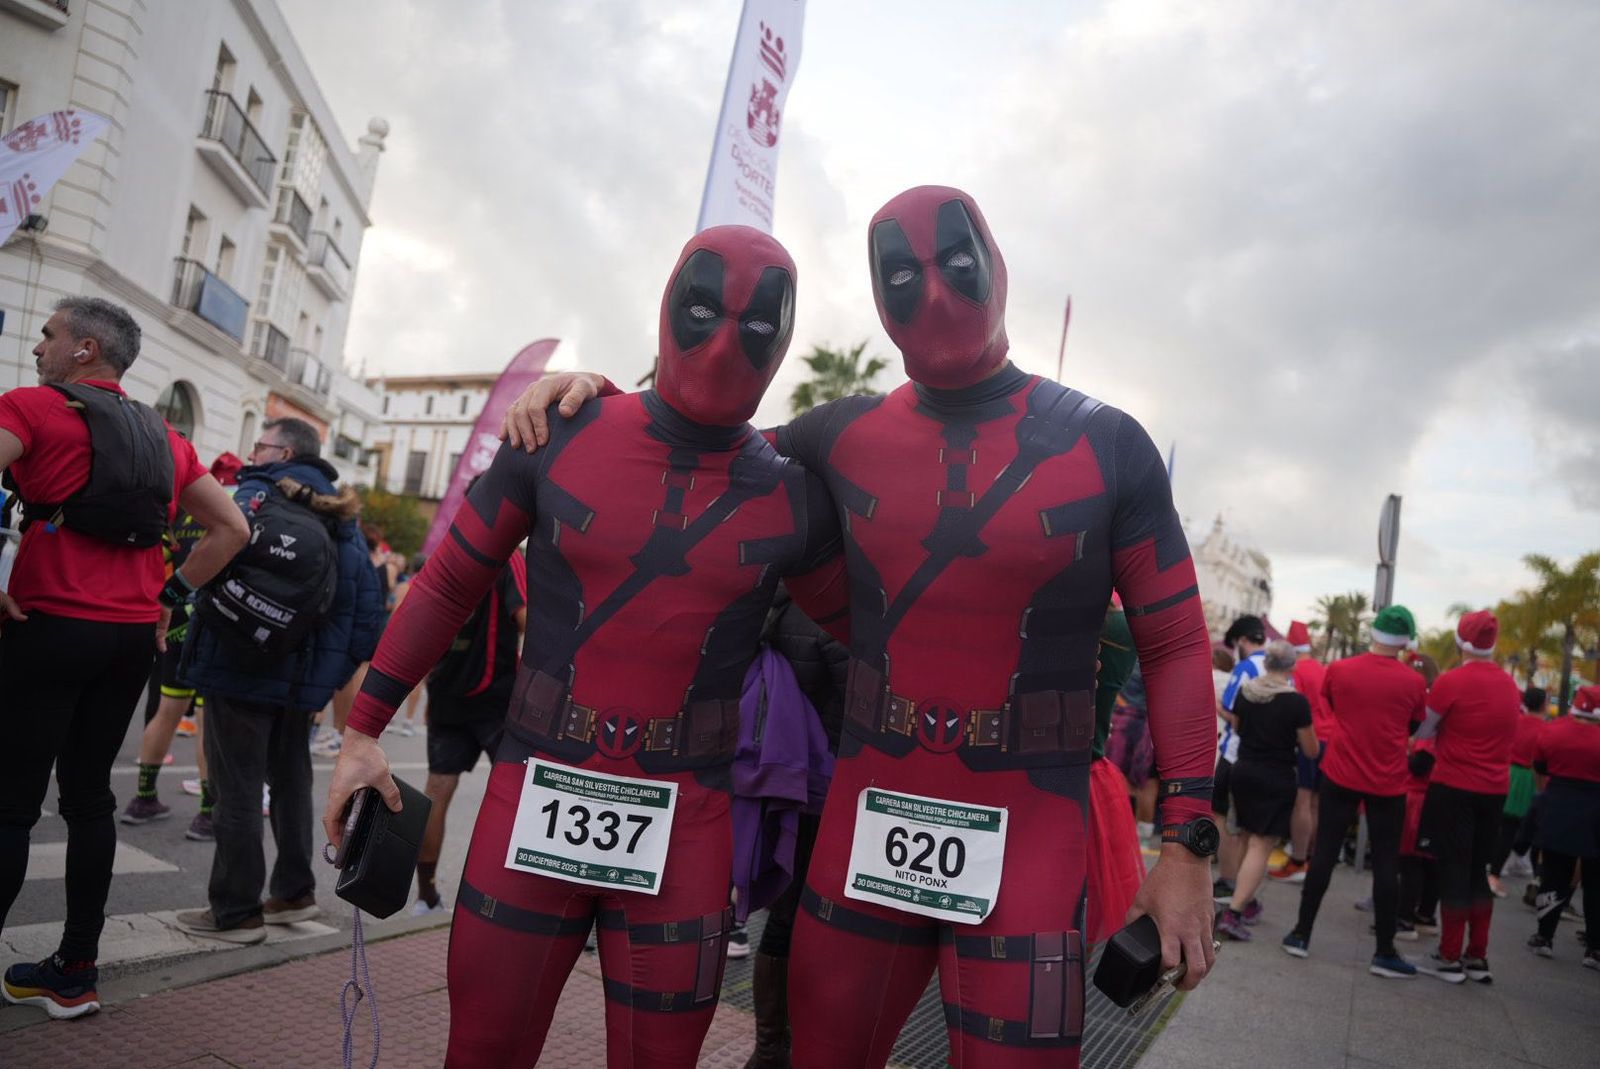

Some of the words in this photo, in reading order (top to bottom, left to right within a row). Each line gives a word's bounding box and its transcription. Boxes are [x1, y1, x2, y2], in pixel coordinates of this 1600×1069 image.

[544, 770, 571, 784] CARRERA
[572, 776, 584, 786] SAN
[584, 780, 620, 793] SILVESTRE
[620, 786, 660, 799] CHICLANERA
[875, 796, 900, 806] CARRERA
[901, 801, 912, 810] SAN
[913, 803, 947, 816] SILVESTRE
[948, 809, 990, 822] CHICLANERA
[542, 799, 652, 854] 1337
[518, 852, 527, 861] 30
[528, 854, 560, 868] DICIEMBRE
[561, 862, 578, 873] 2025
[886, 826, 966, 878] 620
[857, 878, 865, 887] 30
[867, 880, 895, 894] DICIEMBRE
[895, 888, 912, 898] 2025
[895, 870, 917, 882] NITO
[919, 876, 947, 888] PONX
